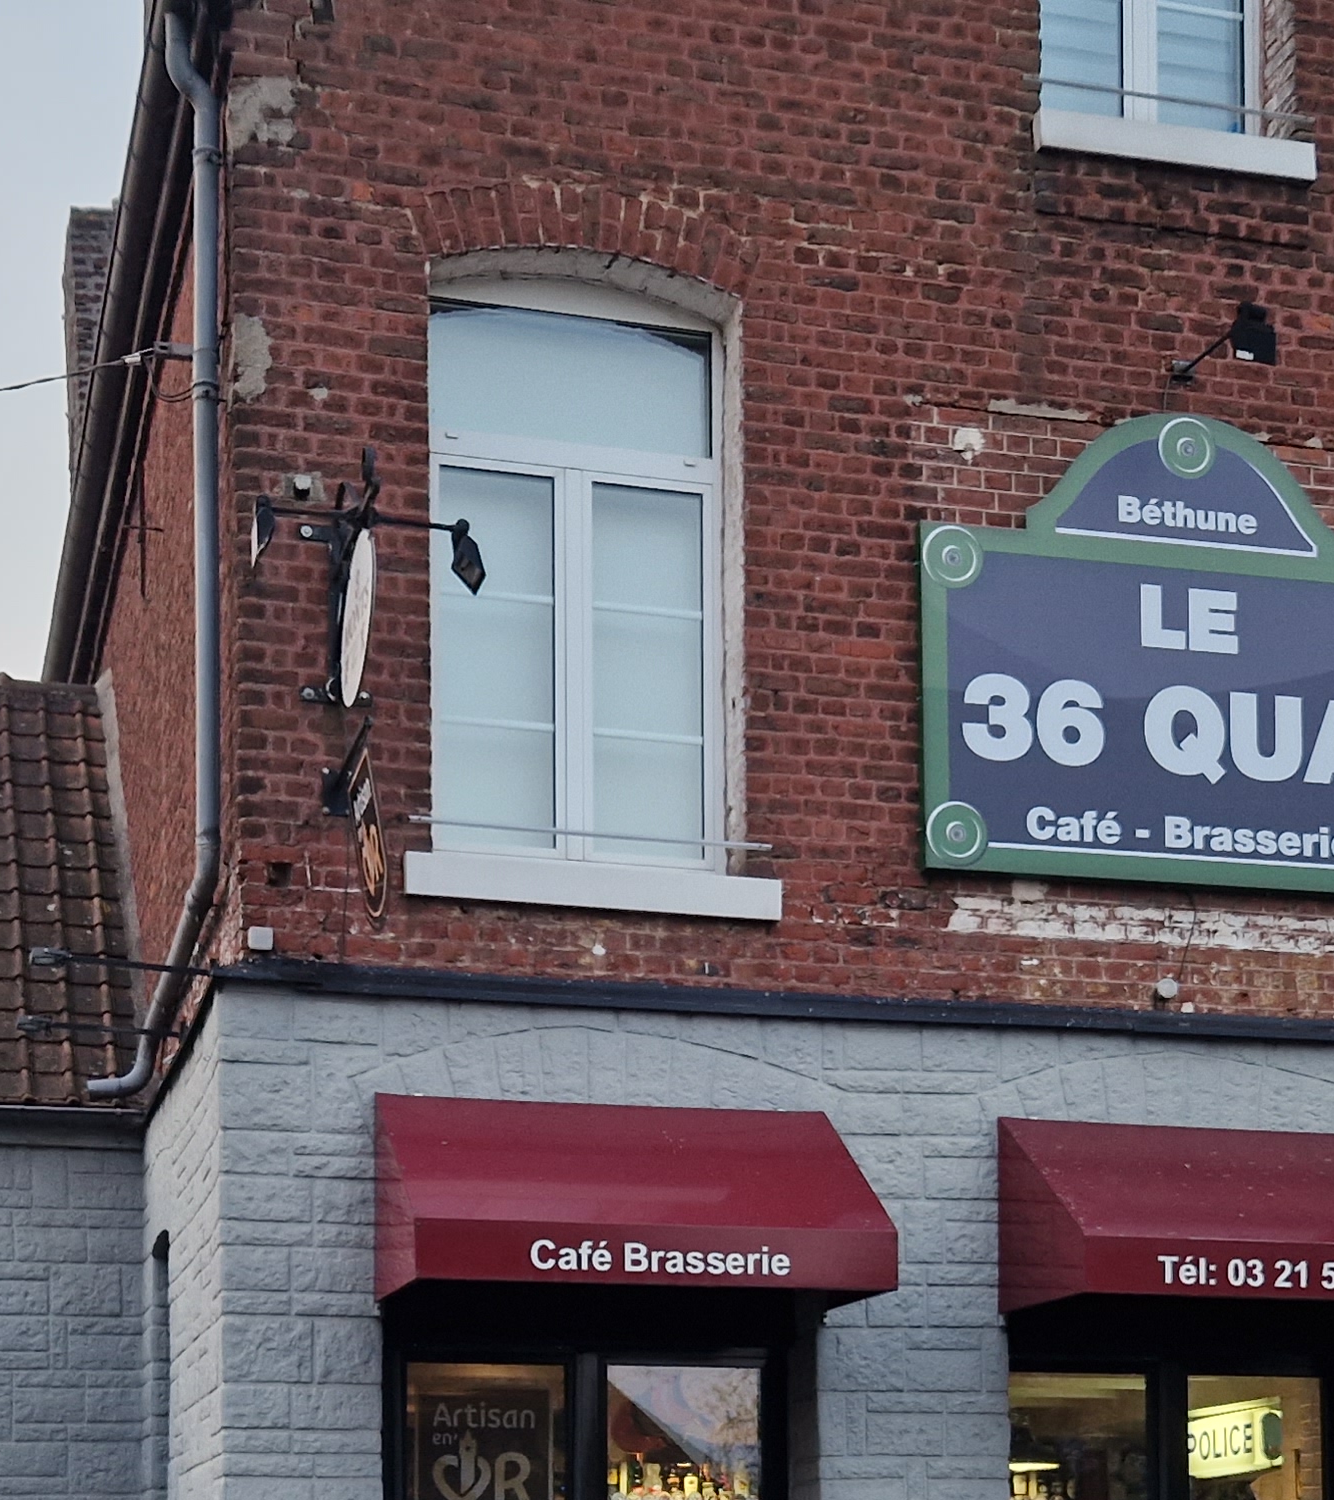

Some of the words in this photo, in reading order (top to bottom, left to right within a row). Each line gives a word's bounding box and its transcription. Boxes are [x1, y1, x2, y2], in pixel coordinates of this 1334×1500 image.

[1117, 494, 1259, 535] Béthune
[1139, 583, 1239, 655] LE
[961, 672, 1105, 767] 36
[1026, 806, 1122, 846] Café
[530, 1239, 612, 1271] Café
[624, 1242, 791, 1276] Brasserie
[1157, 1255, 1217, 1285] Tél:
[1227, 1258, 1265, 1288] 03
[1274, 1260, 1308, 1288] 21
[433, 1401, 535, 1429] Artisan
[1187, 1423, 1253, 1461] POLICE
